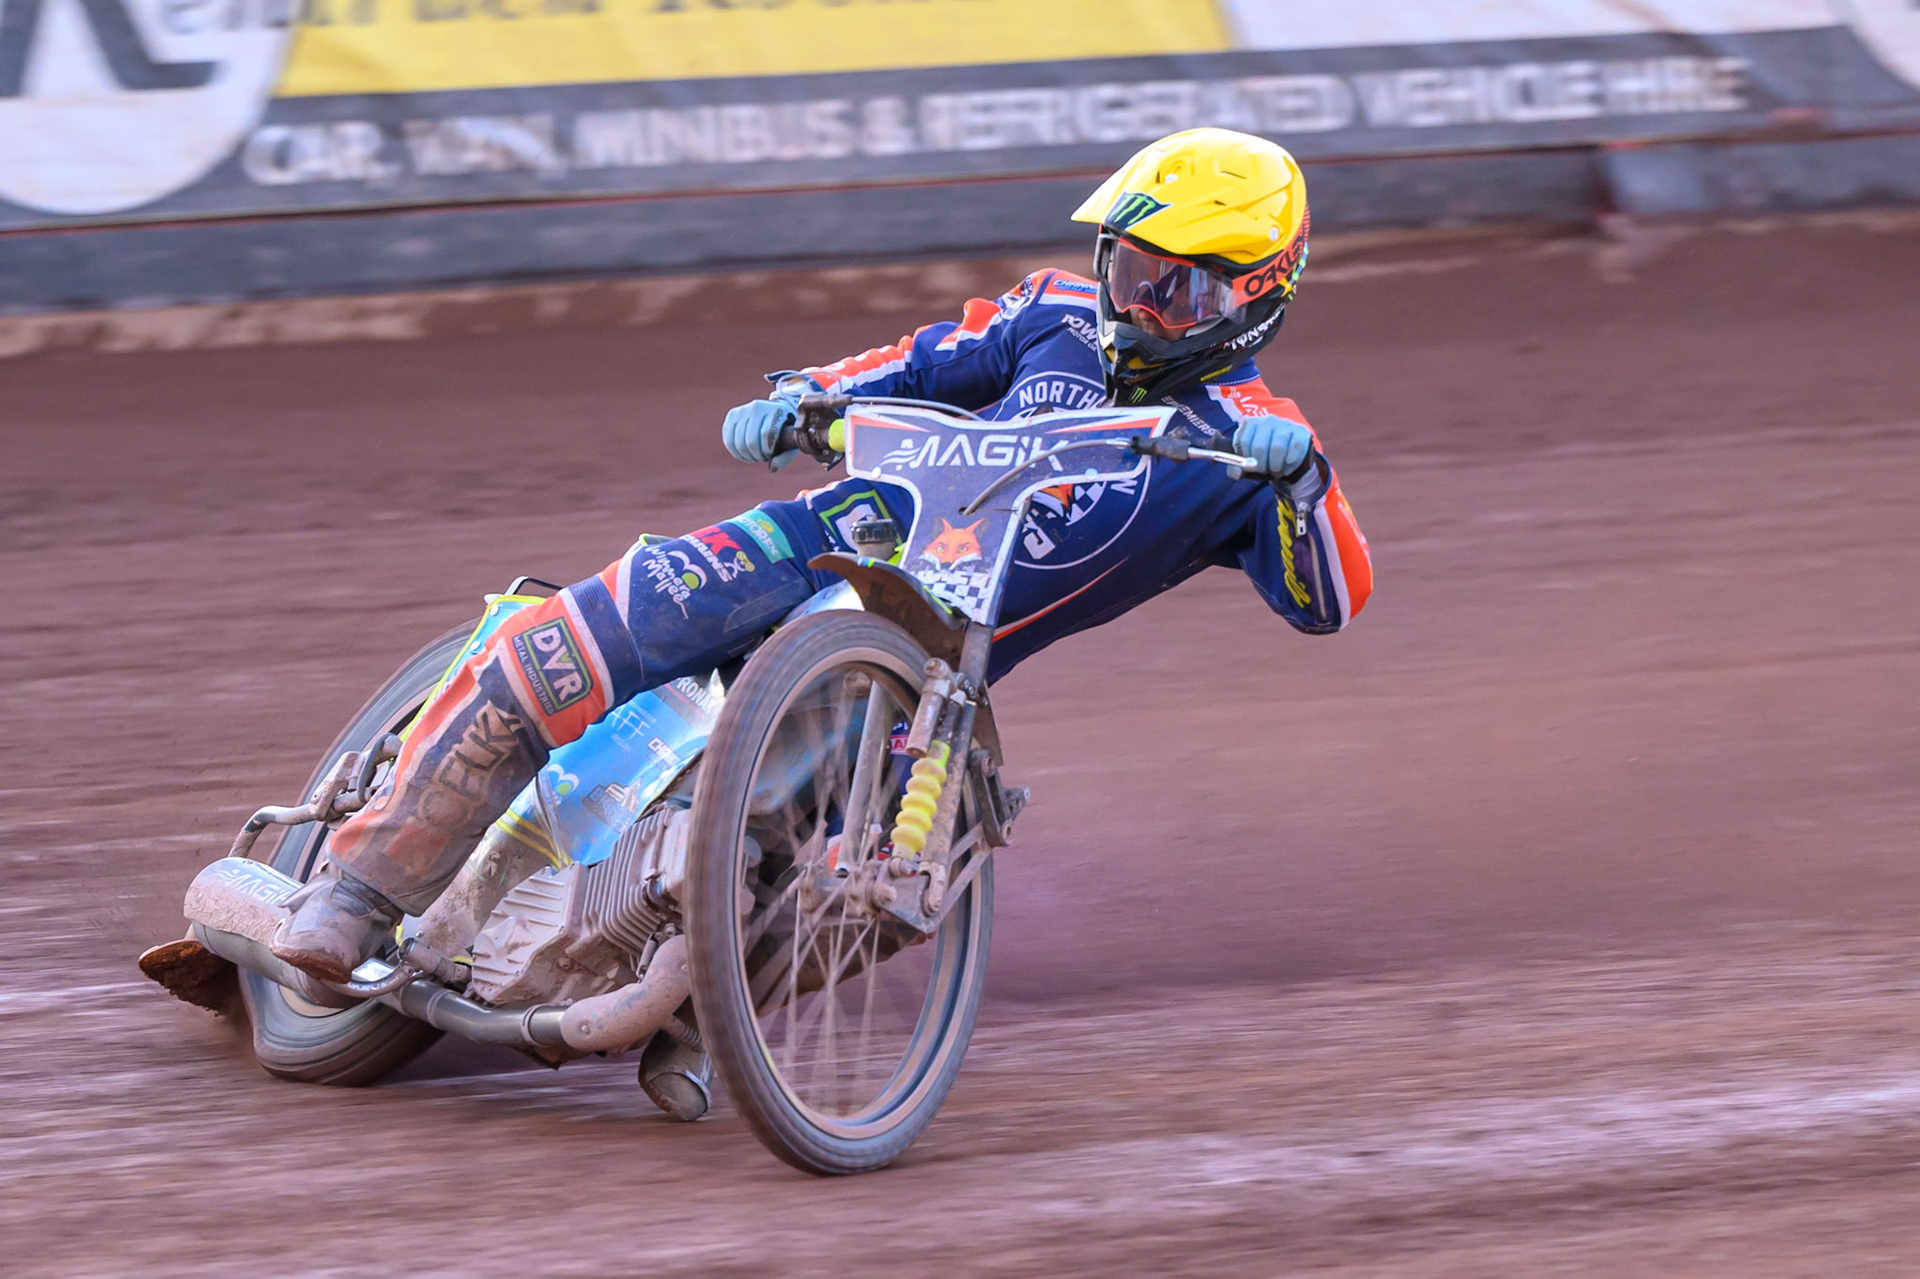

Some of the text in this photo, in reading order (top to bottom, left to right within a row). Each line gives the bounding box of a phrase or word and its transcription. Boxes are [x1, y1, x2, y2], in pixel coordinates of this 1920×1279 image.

[893, 434, 1068, 471] MAGIK
[513, 635, 528, 662] METAL
[531, 626, 582, 702] DVR
